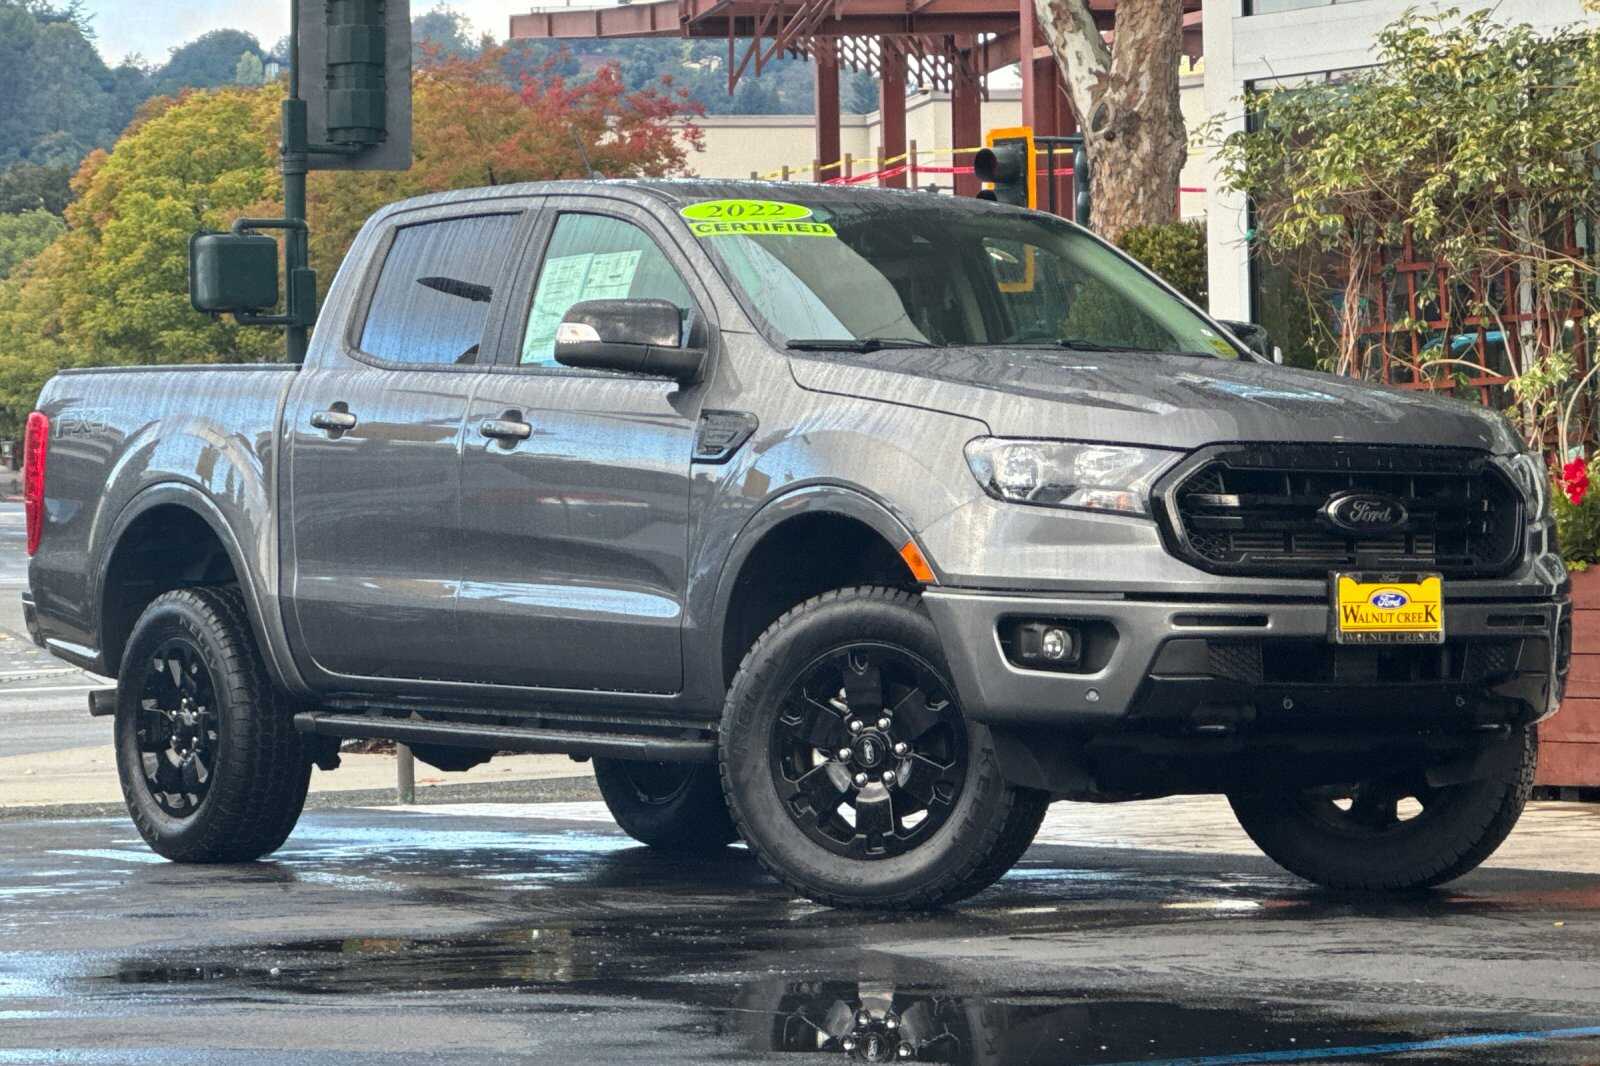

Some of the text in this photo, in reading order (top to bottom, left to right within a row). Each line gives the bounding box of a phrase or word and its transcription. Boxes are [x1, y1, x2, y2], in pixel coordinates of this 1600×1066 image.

[706, 204, 785, 217] 2022
[695, 223, 828, 233] CERTIFIED
[1350, 500, 1391, 522] Ford
[1377, 594, 1402, 607] Ford
[1342, 604, 1438, 624] WALNUT CREEK
